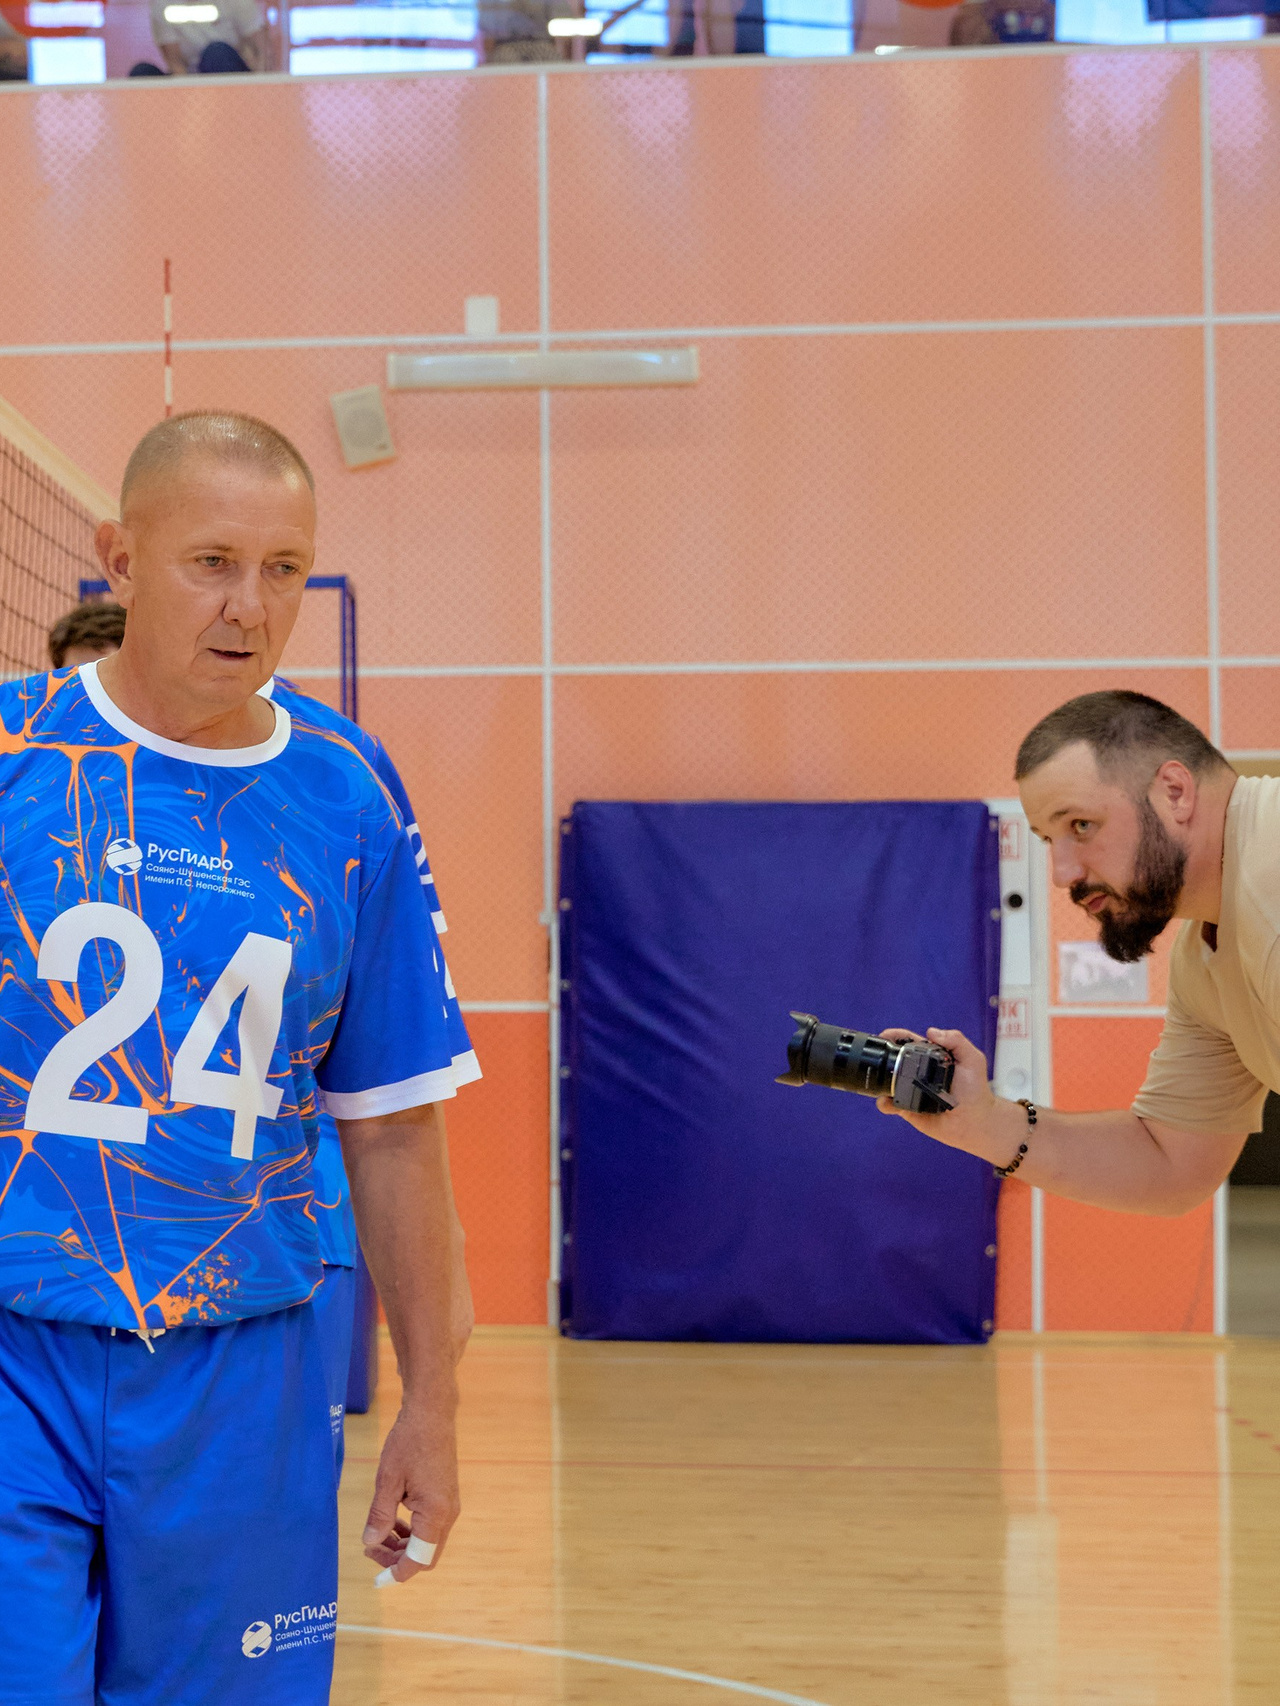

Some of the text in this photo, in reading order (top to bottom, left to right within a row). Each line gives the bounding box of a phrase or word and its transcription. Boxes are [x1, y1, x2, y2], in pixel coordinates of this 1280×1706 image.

[147, 843, 234, 871] РусГидро
[144, 874, 256, 900] имени П.С. Непорожнего
[145, 862, 251, 888] Саяно-Шушенская ГЭС
[23, 901, 293, 1161] 24
[274, 1602, 338, 1629] РусГидр
[275, 1641, 303, 1652] имени
[303, 1635, 322, 1646] П.С.
